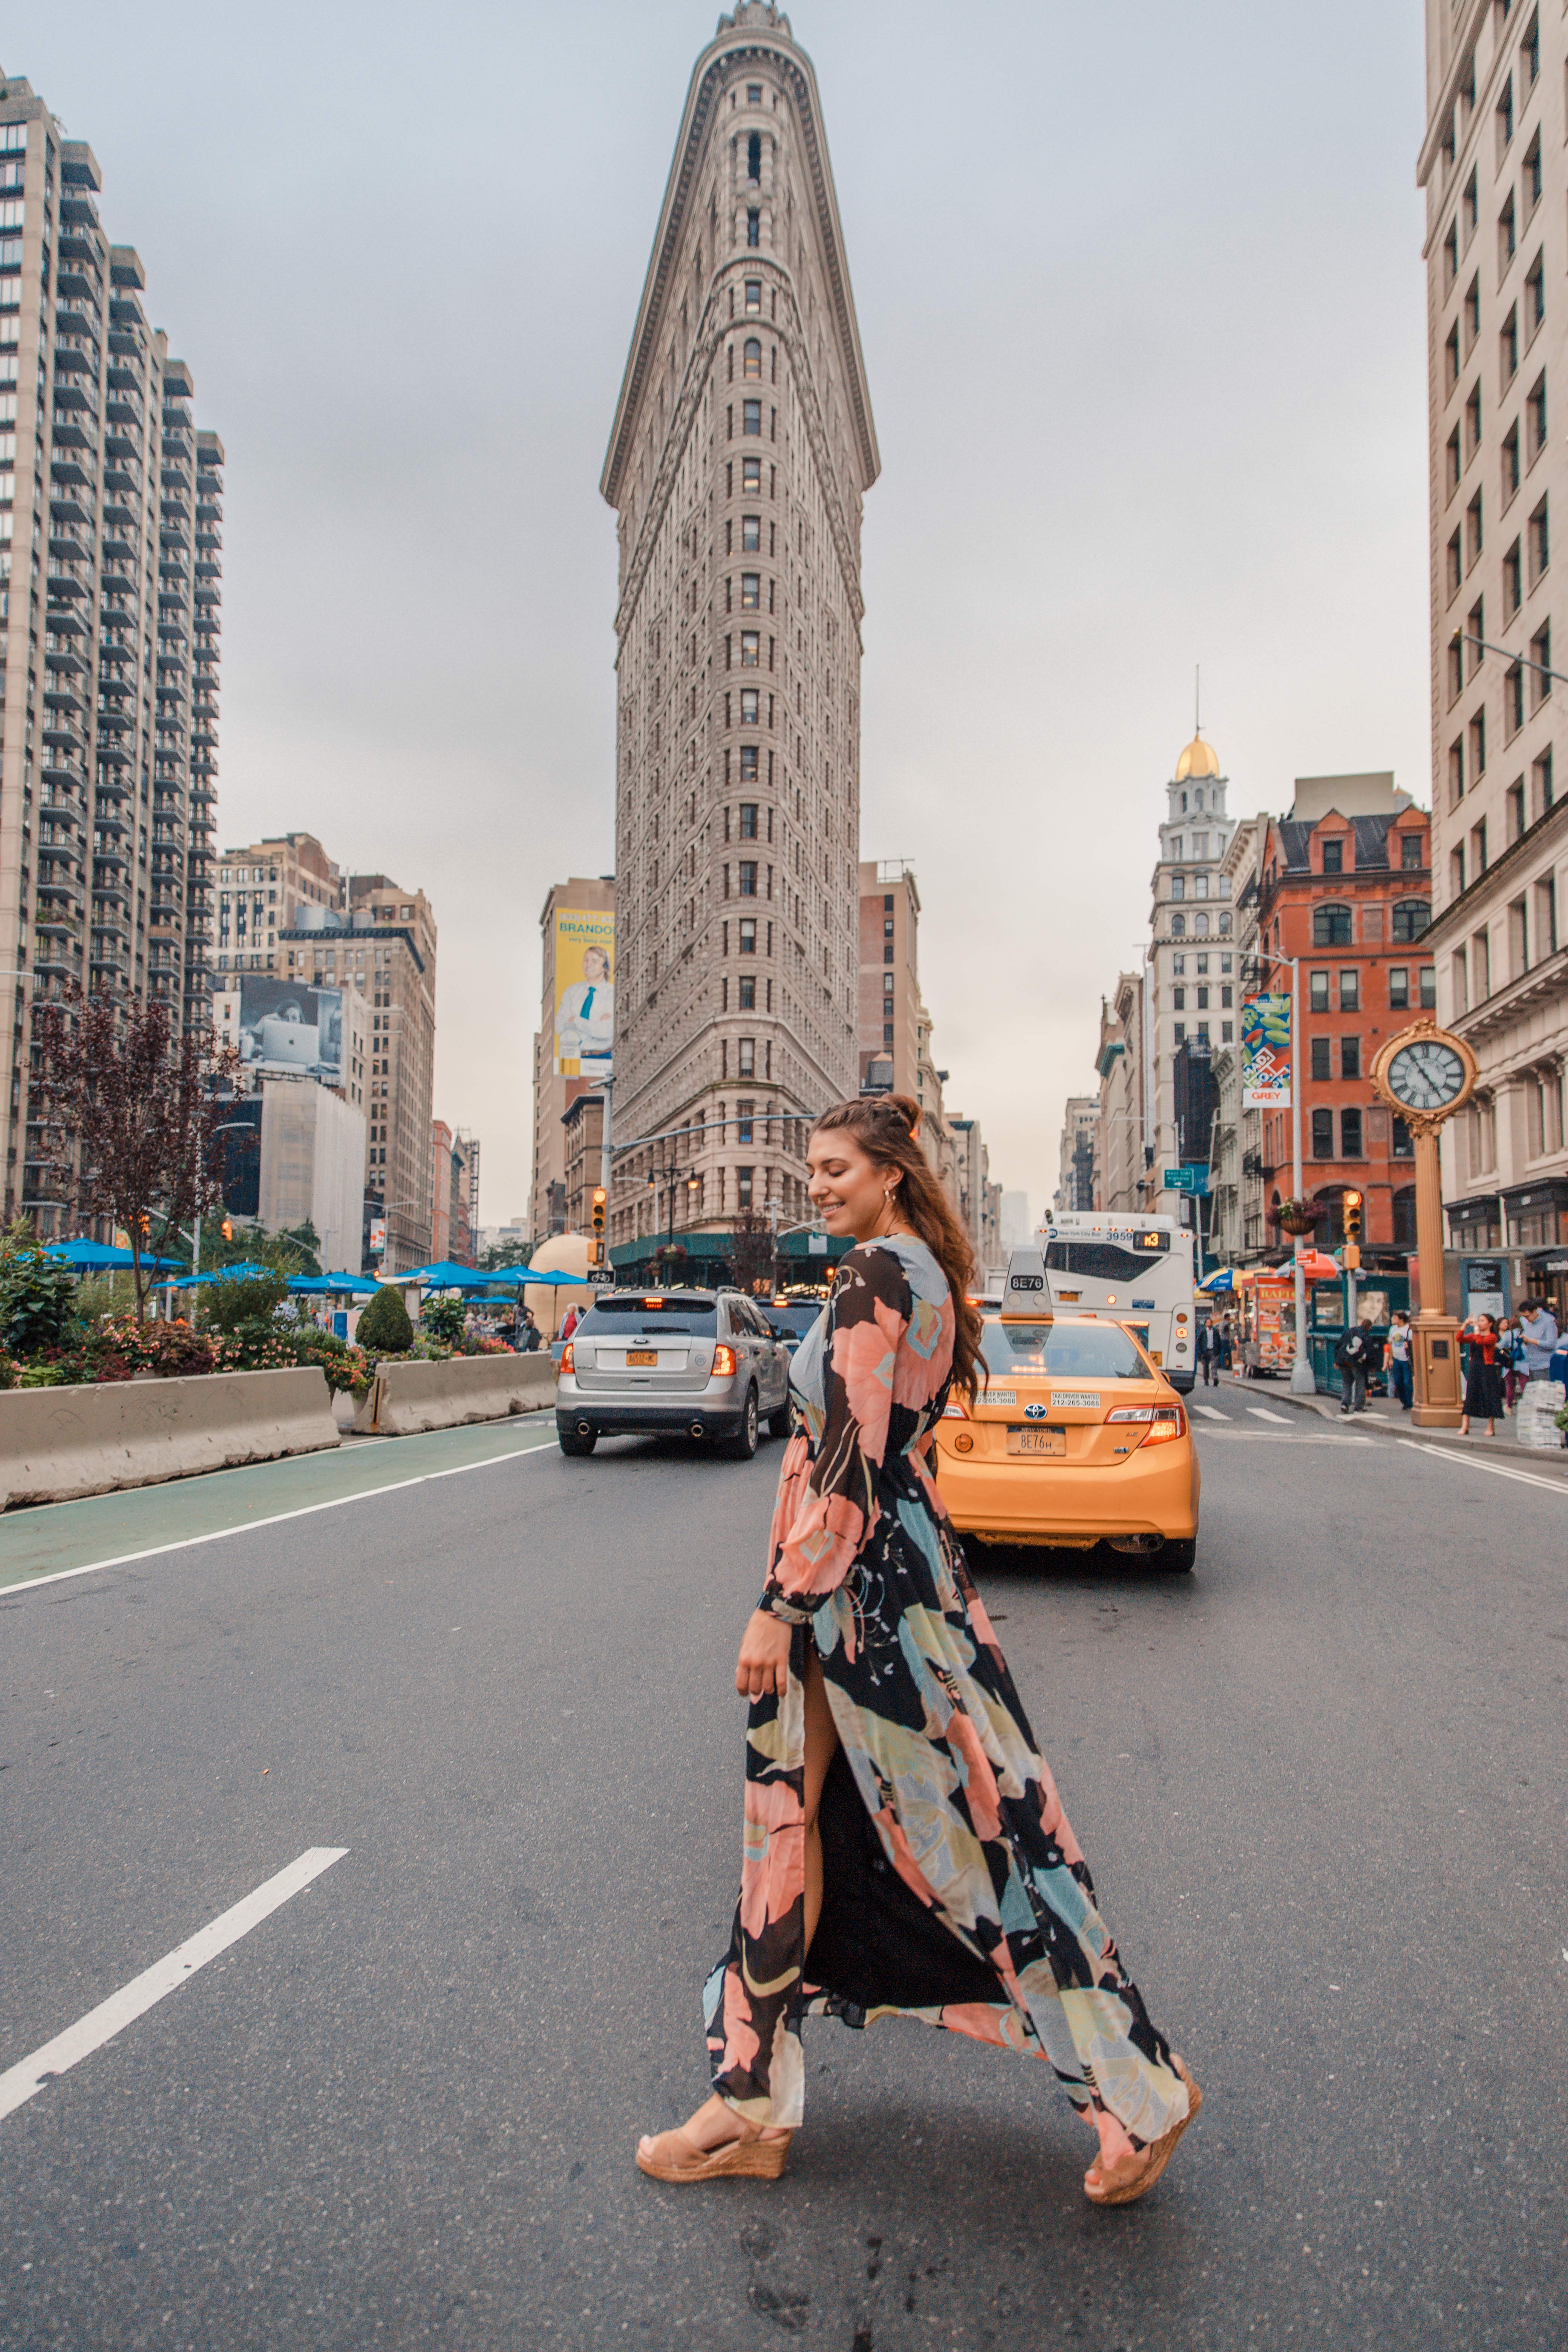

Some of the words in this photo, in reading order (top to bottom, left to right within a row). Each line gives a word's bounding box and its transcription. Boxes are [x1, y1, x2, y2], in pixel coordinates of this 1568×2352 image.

[560, 922, 615, 935] BRANDO
[1251, 1092, 1280, 1100] GREY
[1106, 1232, 1132, 1241] 3959
[1013, 1278, 1042, 1288] 8E76
[1021, 1435, 1052, 1449] 8E76H
